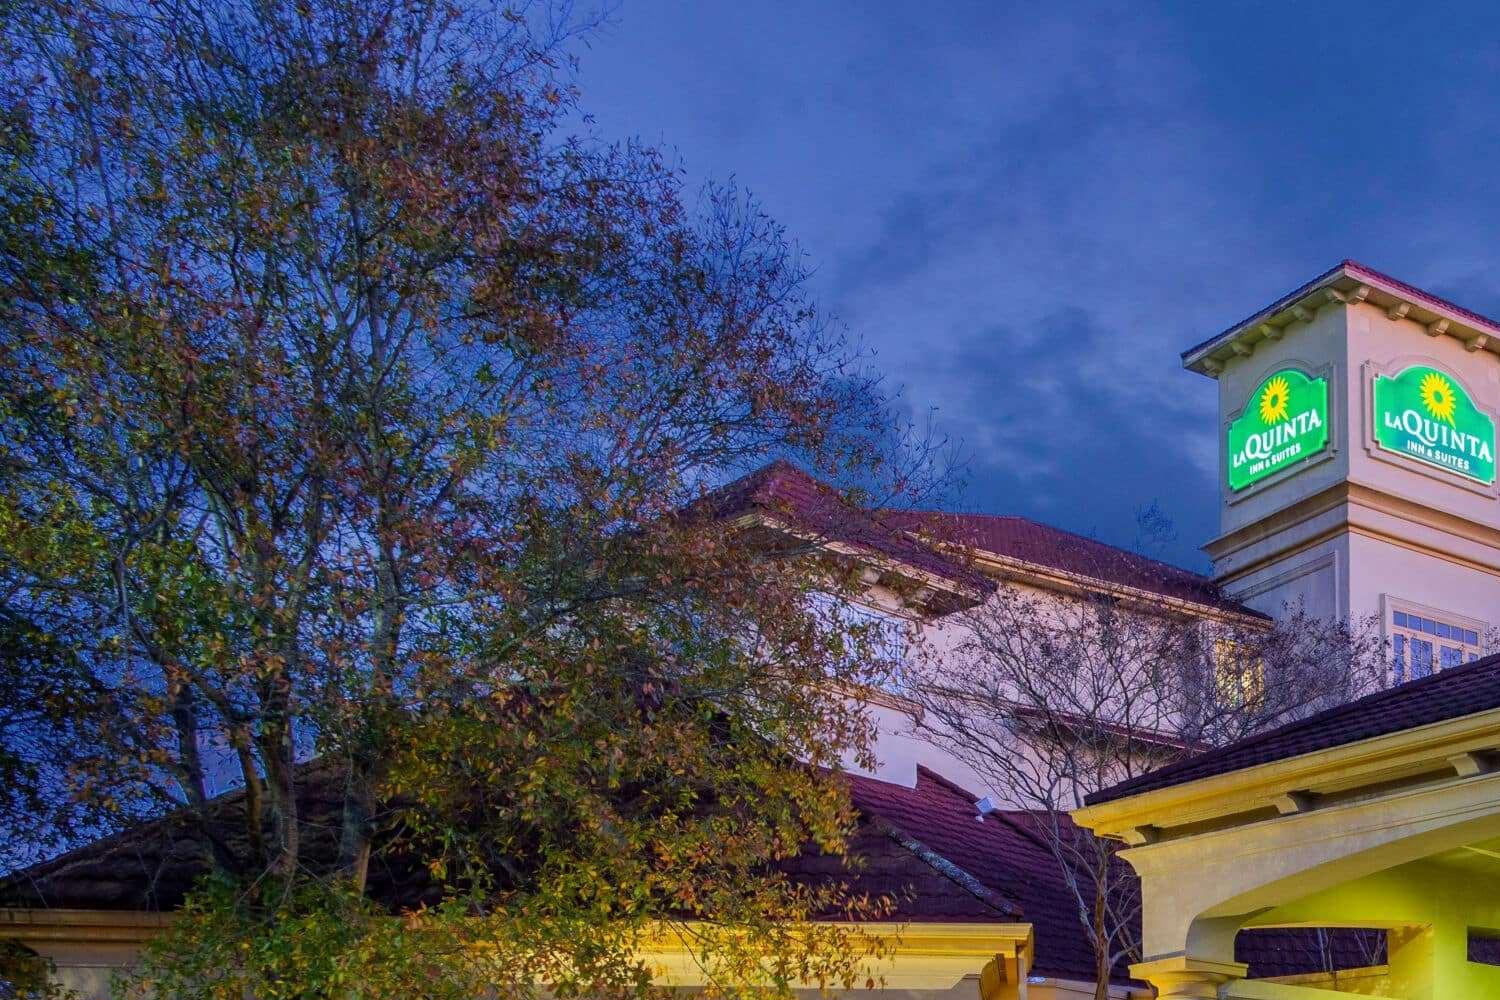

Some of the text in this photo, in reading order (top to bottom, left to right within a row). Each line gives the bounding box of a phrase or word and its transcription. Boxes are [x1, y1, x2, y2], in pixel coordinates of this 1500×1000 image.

[1233, 408, 1322, 468] LA QUINTA
[1384, 409, 1493, 463] LA QUINTA
[1407, 440, 1470, 470] INN & SUITES
[1249, 442, 1301, 475] INN & SUITES
